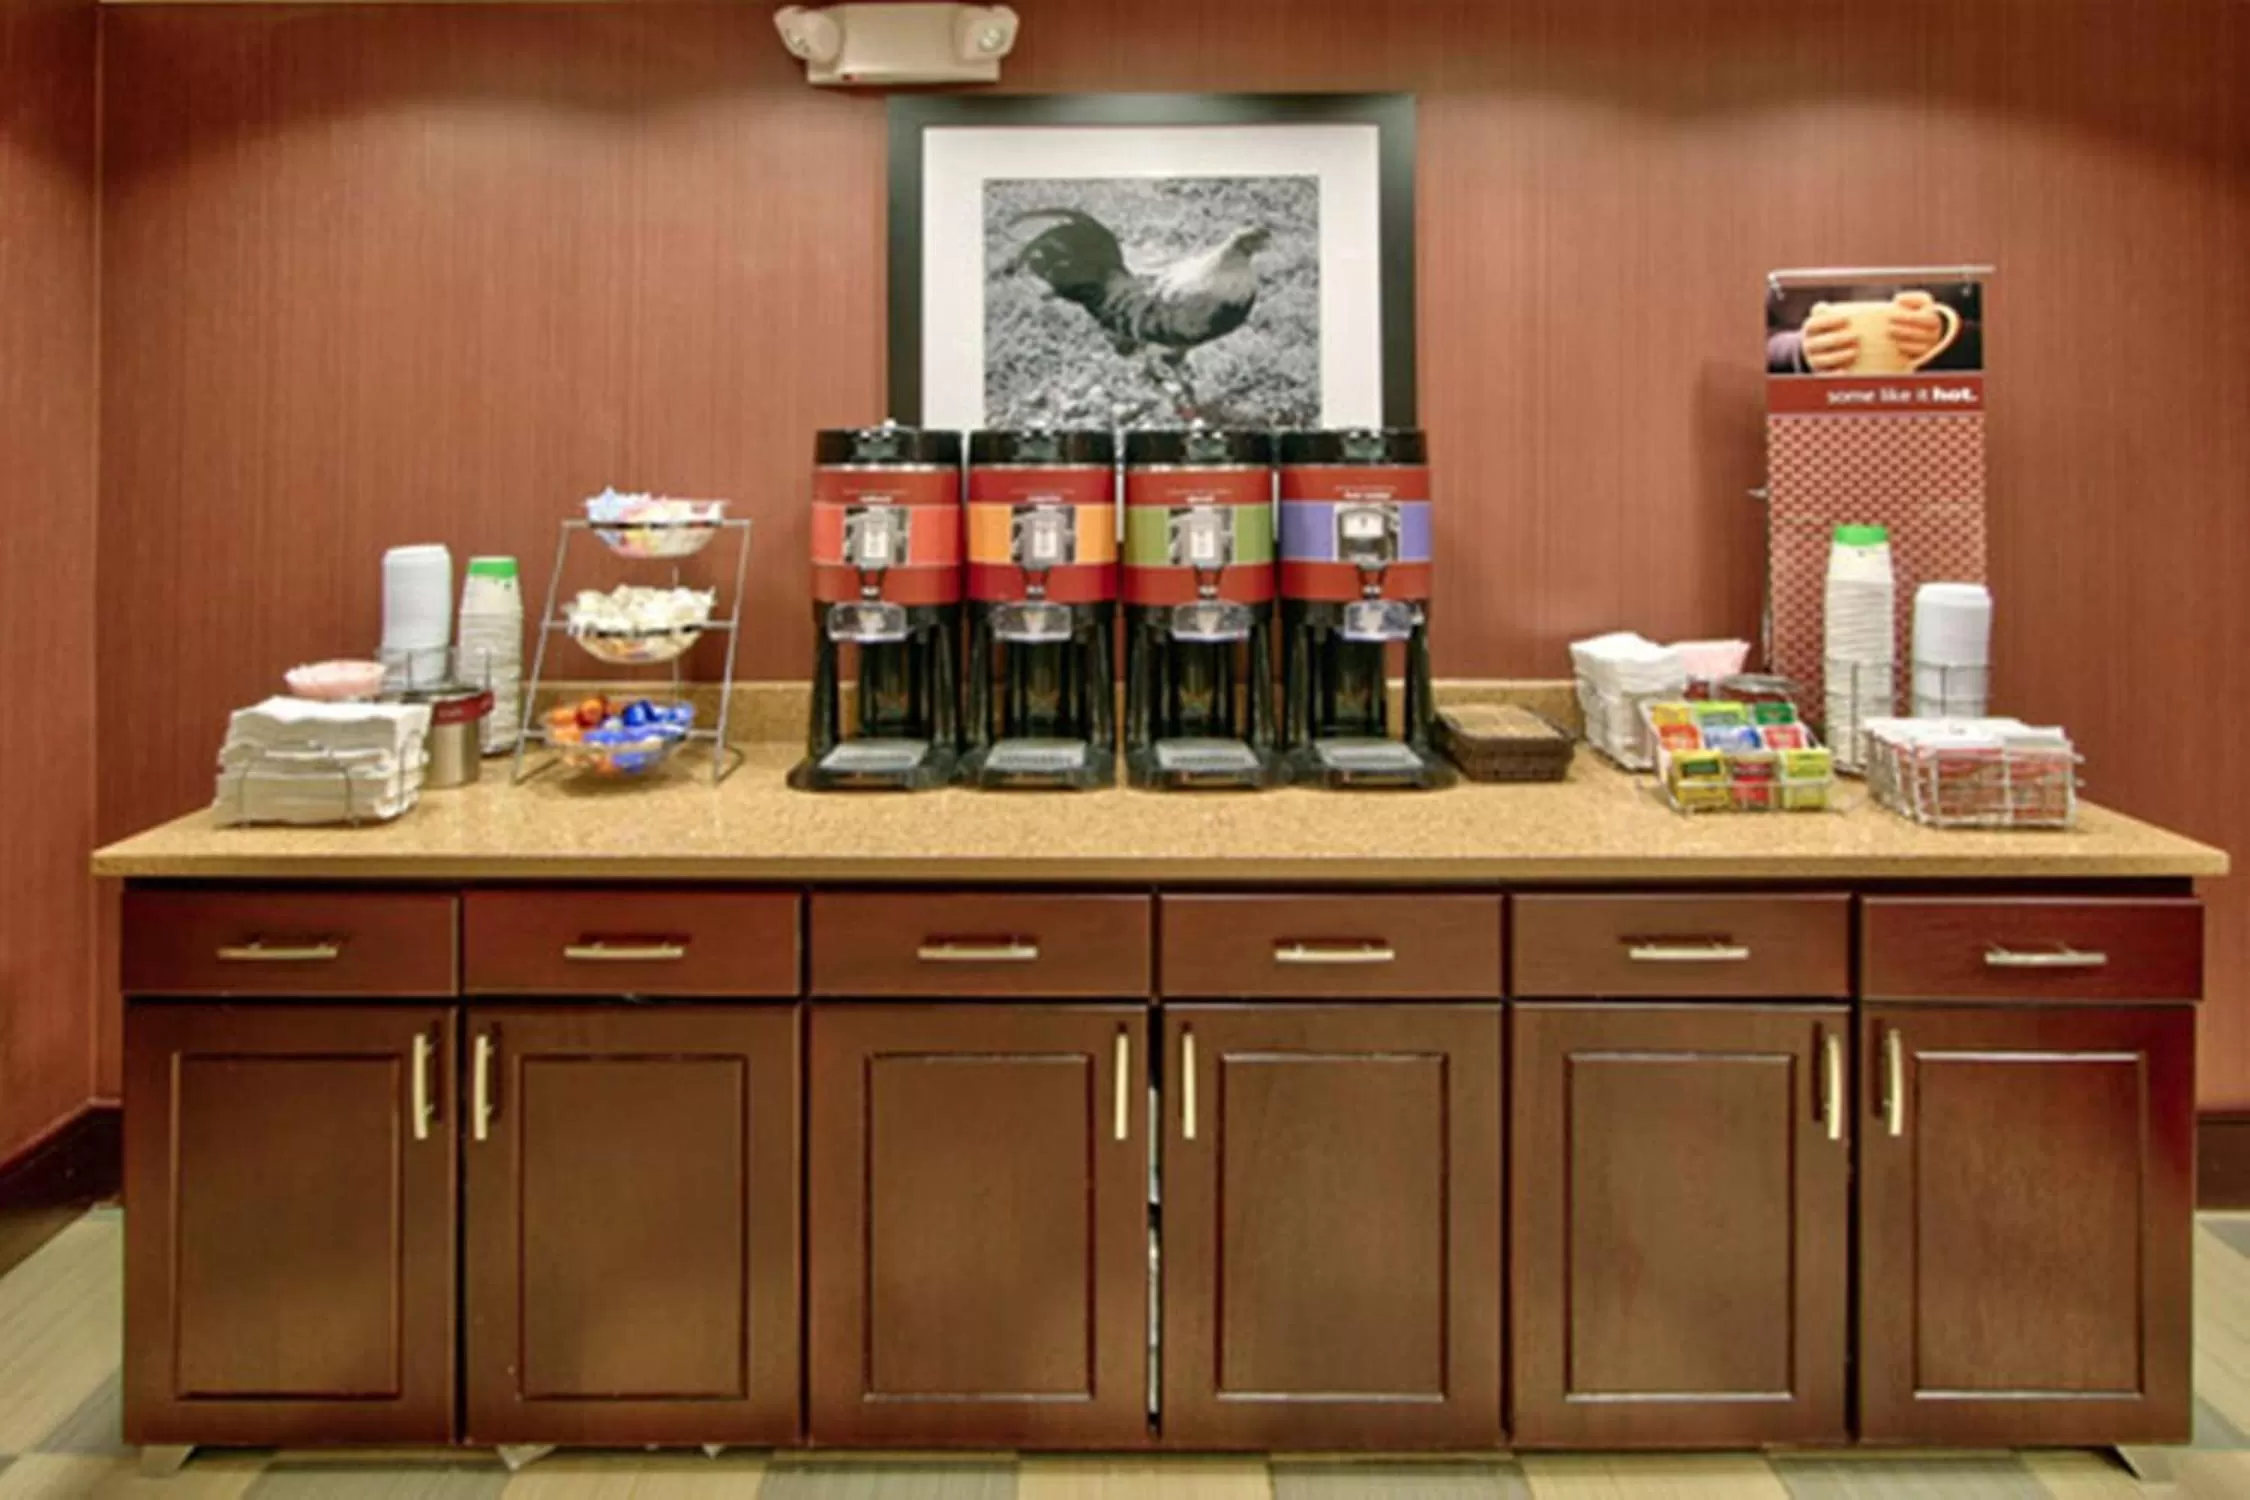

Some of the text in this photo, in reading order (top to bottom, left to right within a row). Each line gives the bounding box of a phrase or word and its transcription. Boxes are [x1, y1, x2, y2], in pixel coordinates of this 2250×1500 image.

[1828, 386, 1978, 404] some like it hot.
